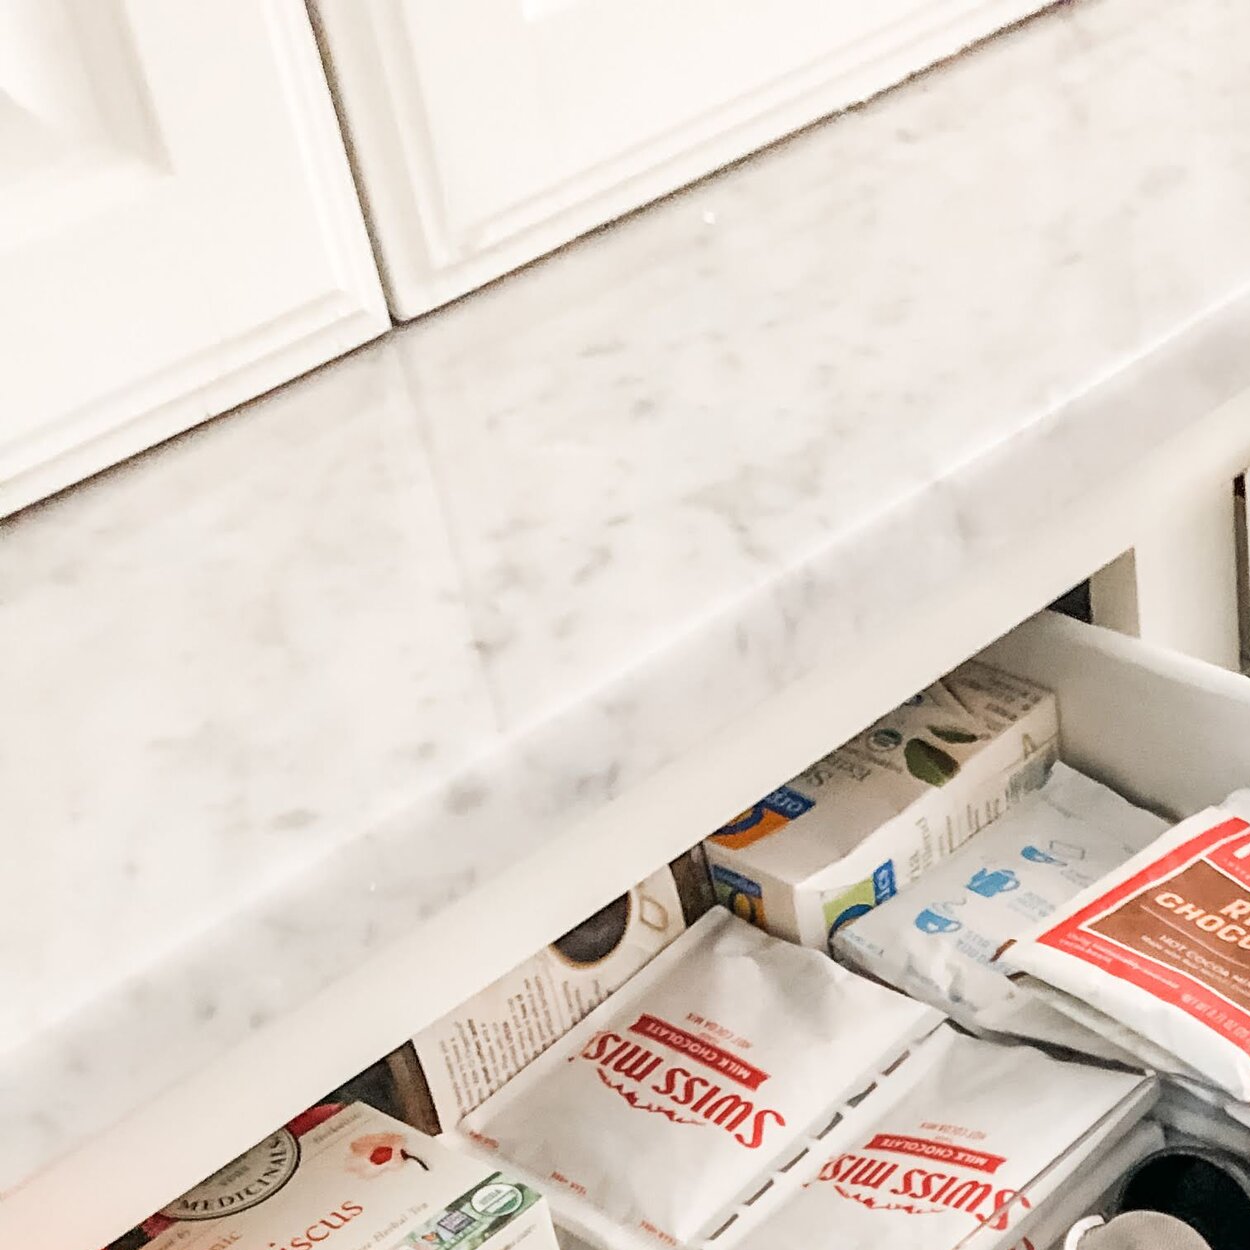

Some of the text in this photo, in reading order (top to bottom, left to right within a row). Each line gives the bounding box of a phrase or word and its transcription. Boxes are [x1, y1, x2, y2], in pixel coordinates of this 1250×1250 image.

[582, 1030, 664, 1083] MIS
[646, 1022, 718, 1063] CHOCOLATE
[717, 1056, 752, 1081] MILK
[651, 1066, 786, 1149] SWISS
[181, 1136, 288, 1212] MEDICINALS
[878, 1137, 989, 1169] MILK CHOCOLATE
[373, 1219, 408, 1243] Herbal
[408, 1200, 430, 1219] Tea
[890, 1168, 1032, 1231] SWISS
